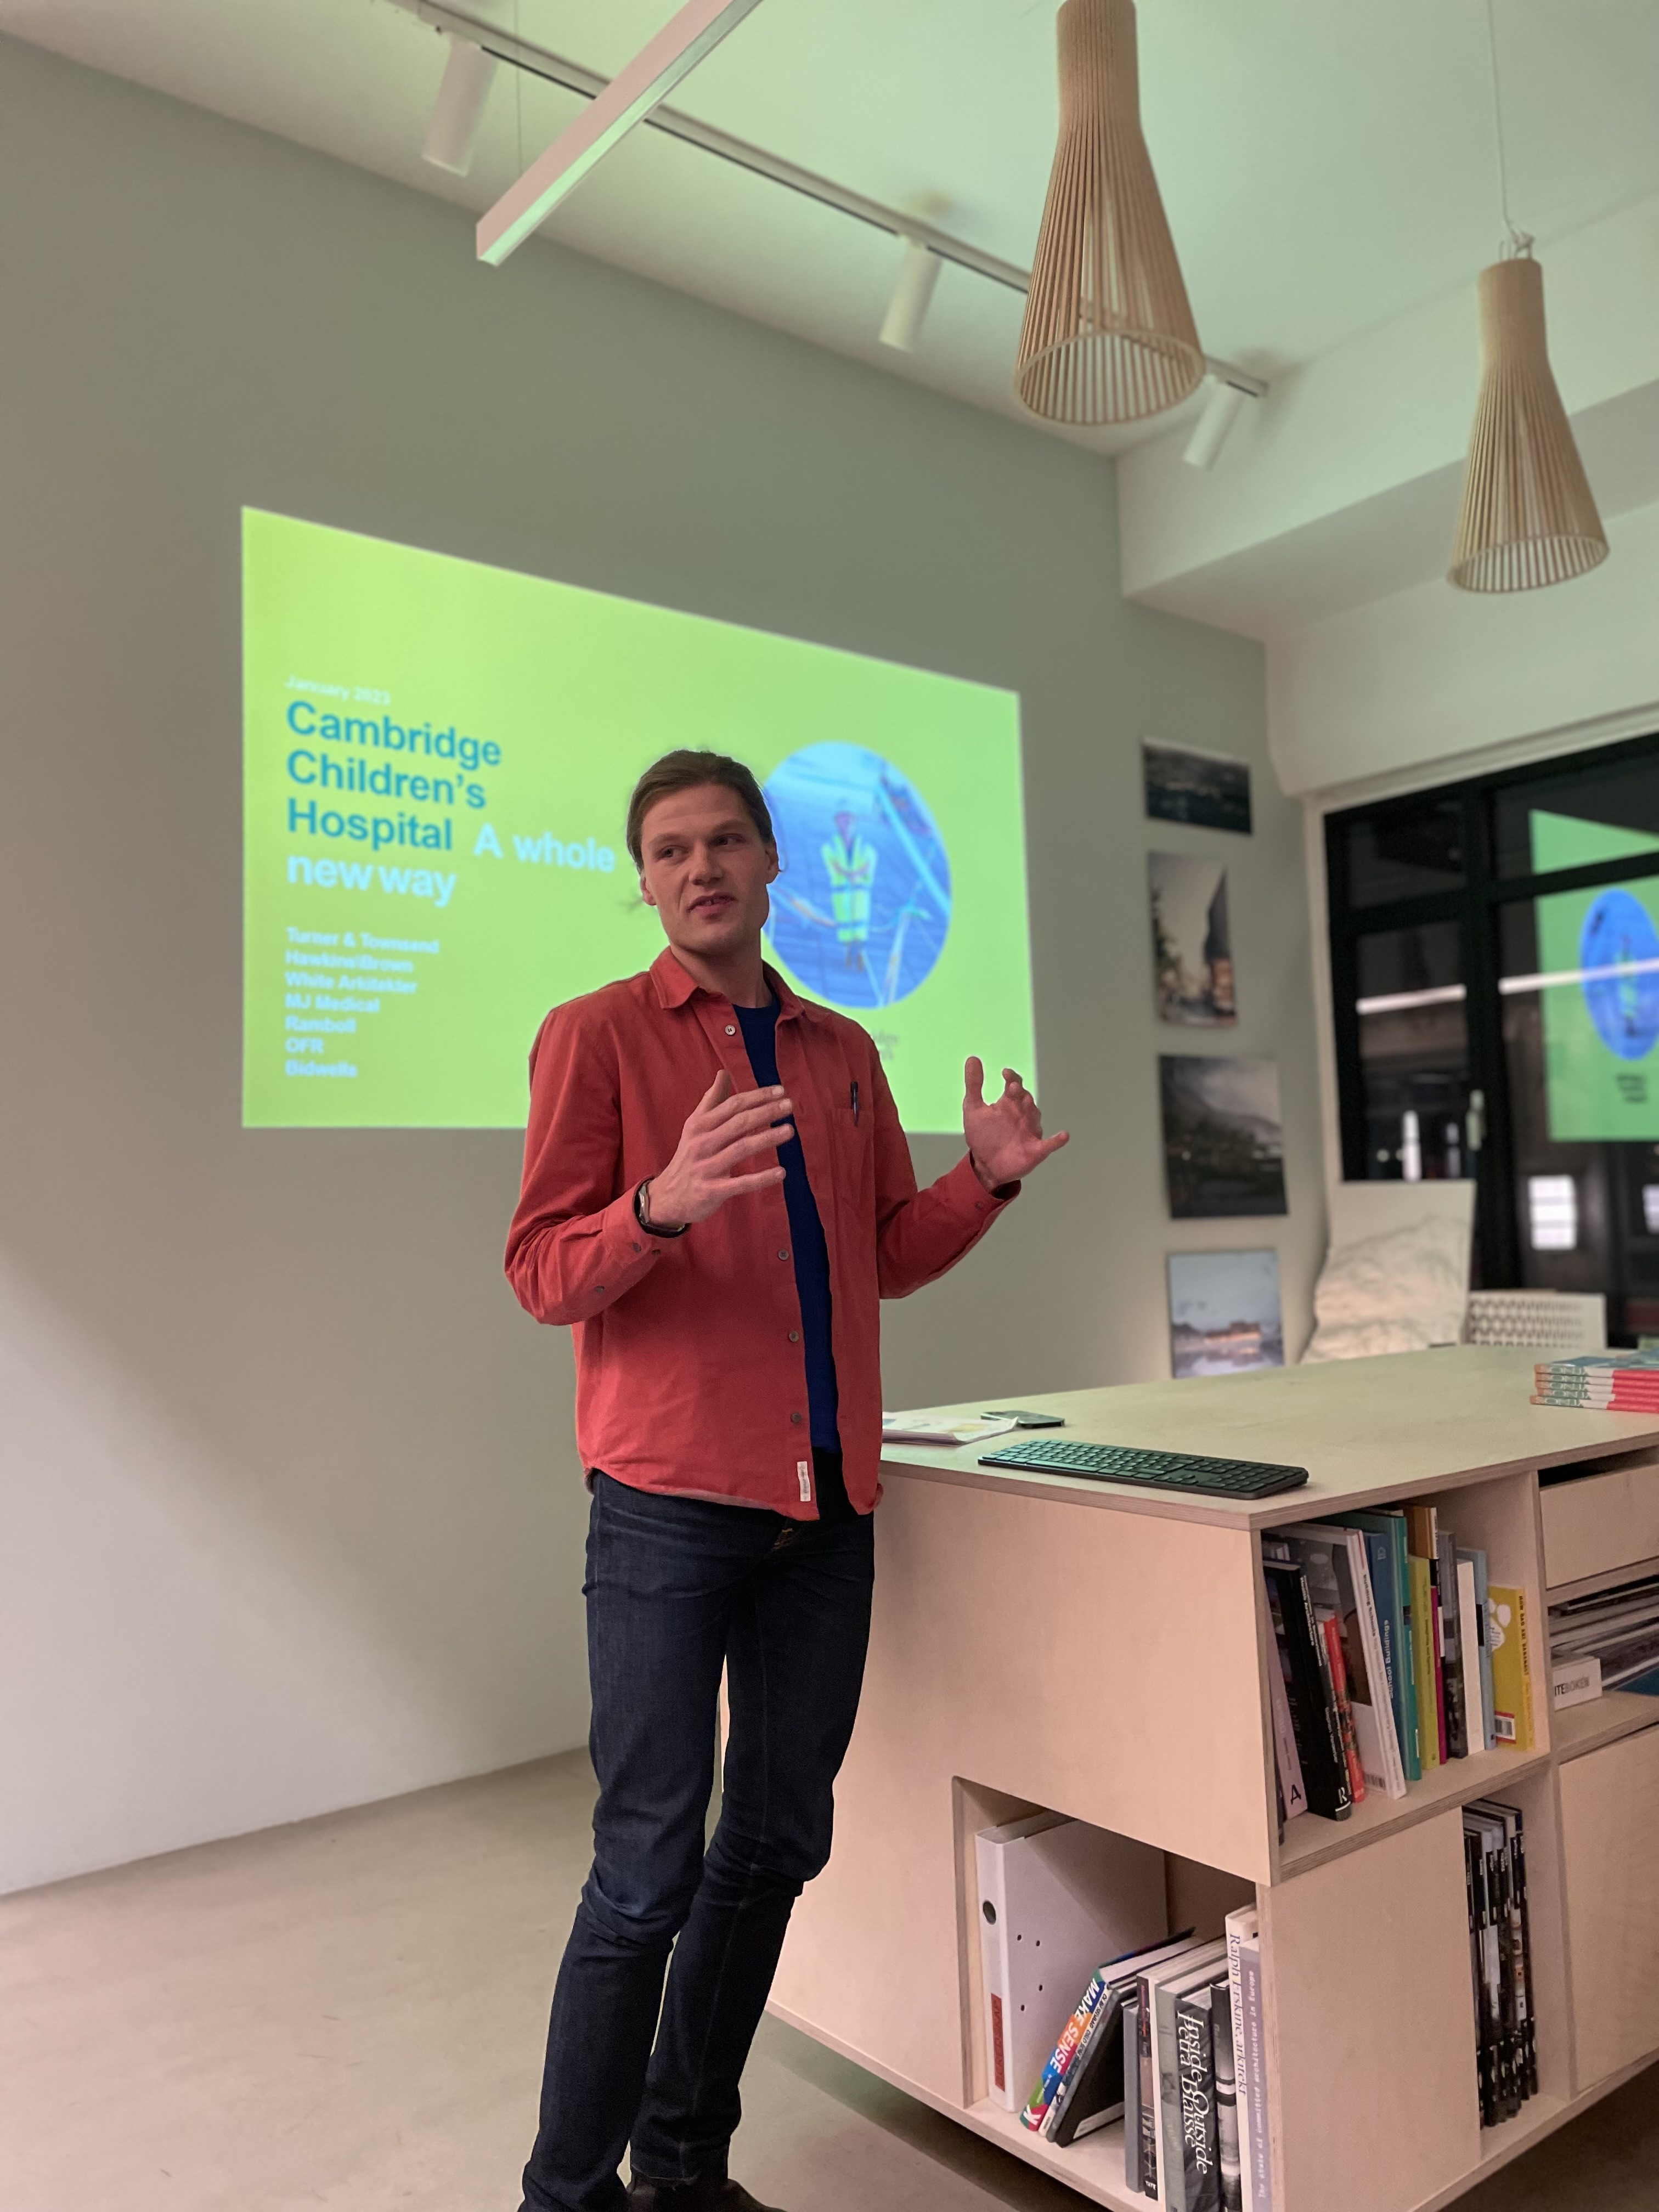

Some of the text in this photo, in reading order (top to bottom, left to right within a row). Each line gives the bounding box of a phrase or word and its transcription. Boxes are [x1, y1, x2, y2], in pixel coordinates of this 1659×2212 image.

[286, 699, 502, 771] Cambridge
[287, 797, 616, 873] Hospital A whole
[286, 855, 457, 908] new way
[1383, 1620, 1391, 1664] Buildings
[1228, 1933, 1241, 1976] Ralph
[1049, 1978, 1100, 2074] MAKE SENSE
[1249, 2006, 1256, 2017] in
[1177, 2011, 1199, 2148] Petra Blaisse
[1251, 2022, 1260, 2083] architecture
[1188, 2017, 1213, 2175] Inside Outside
